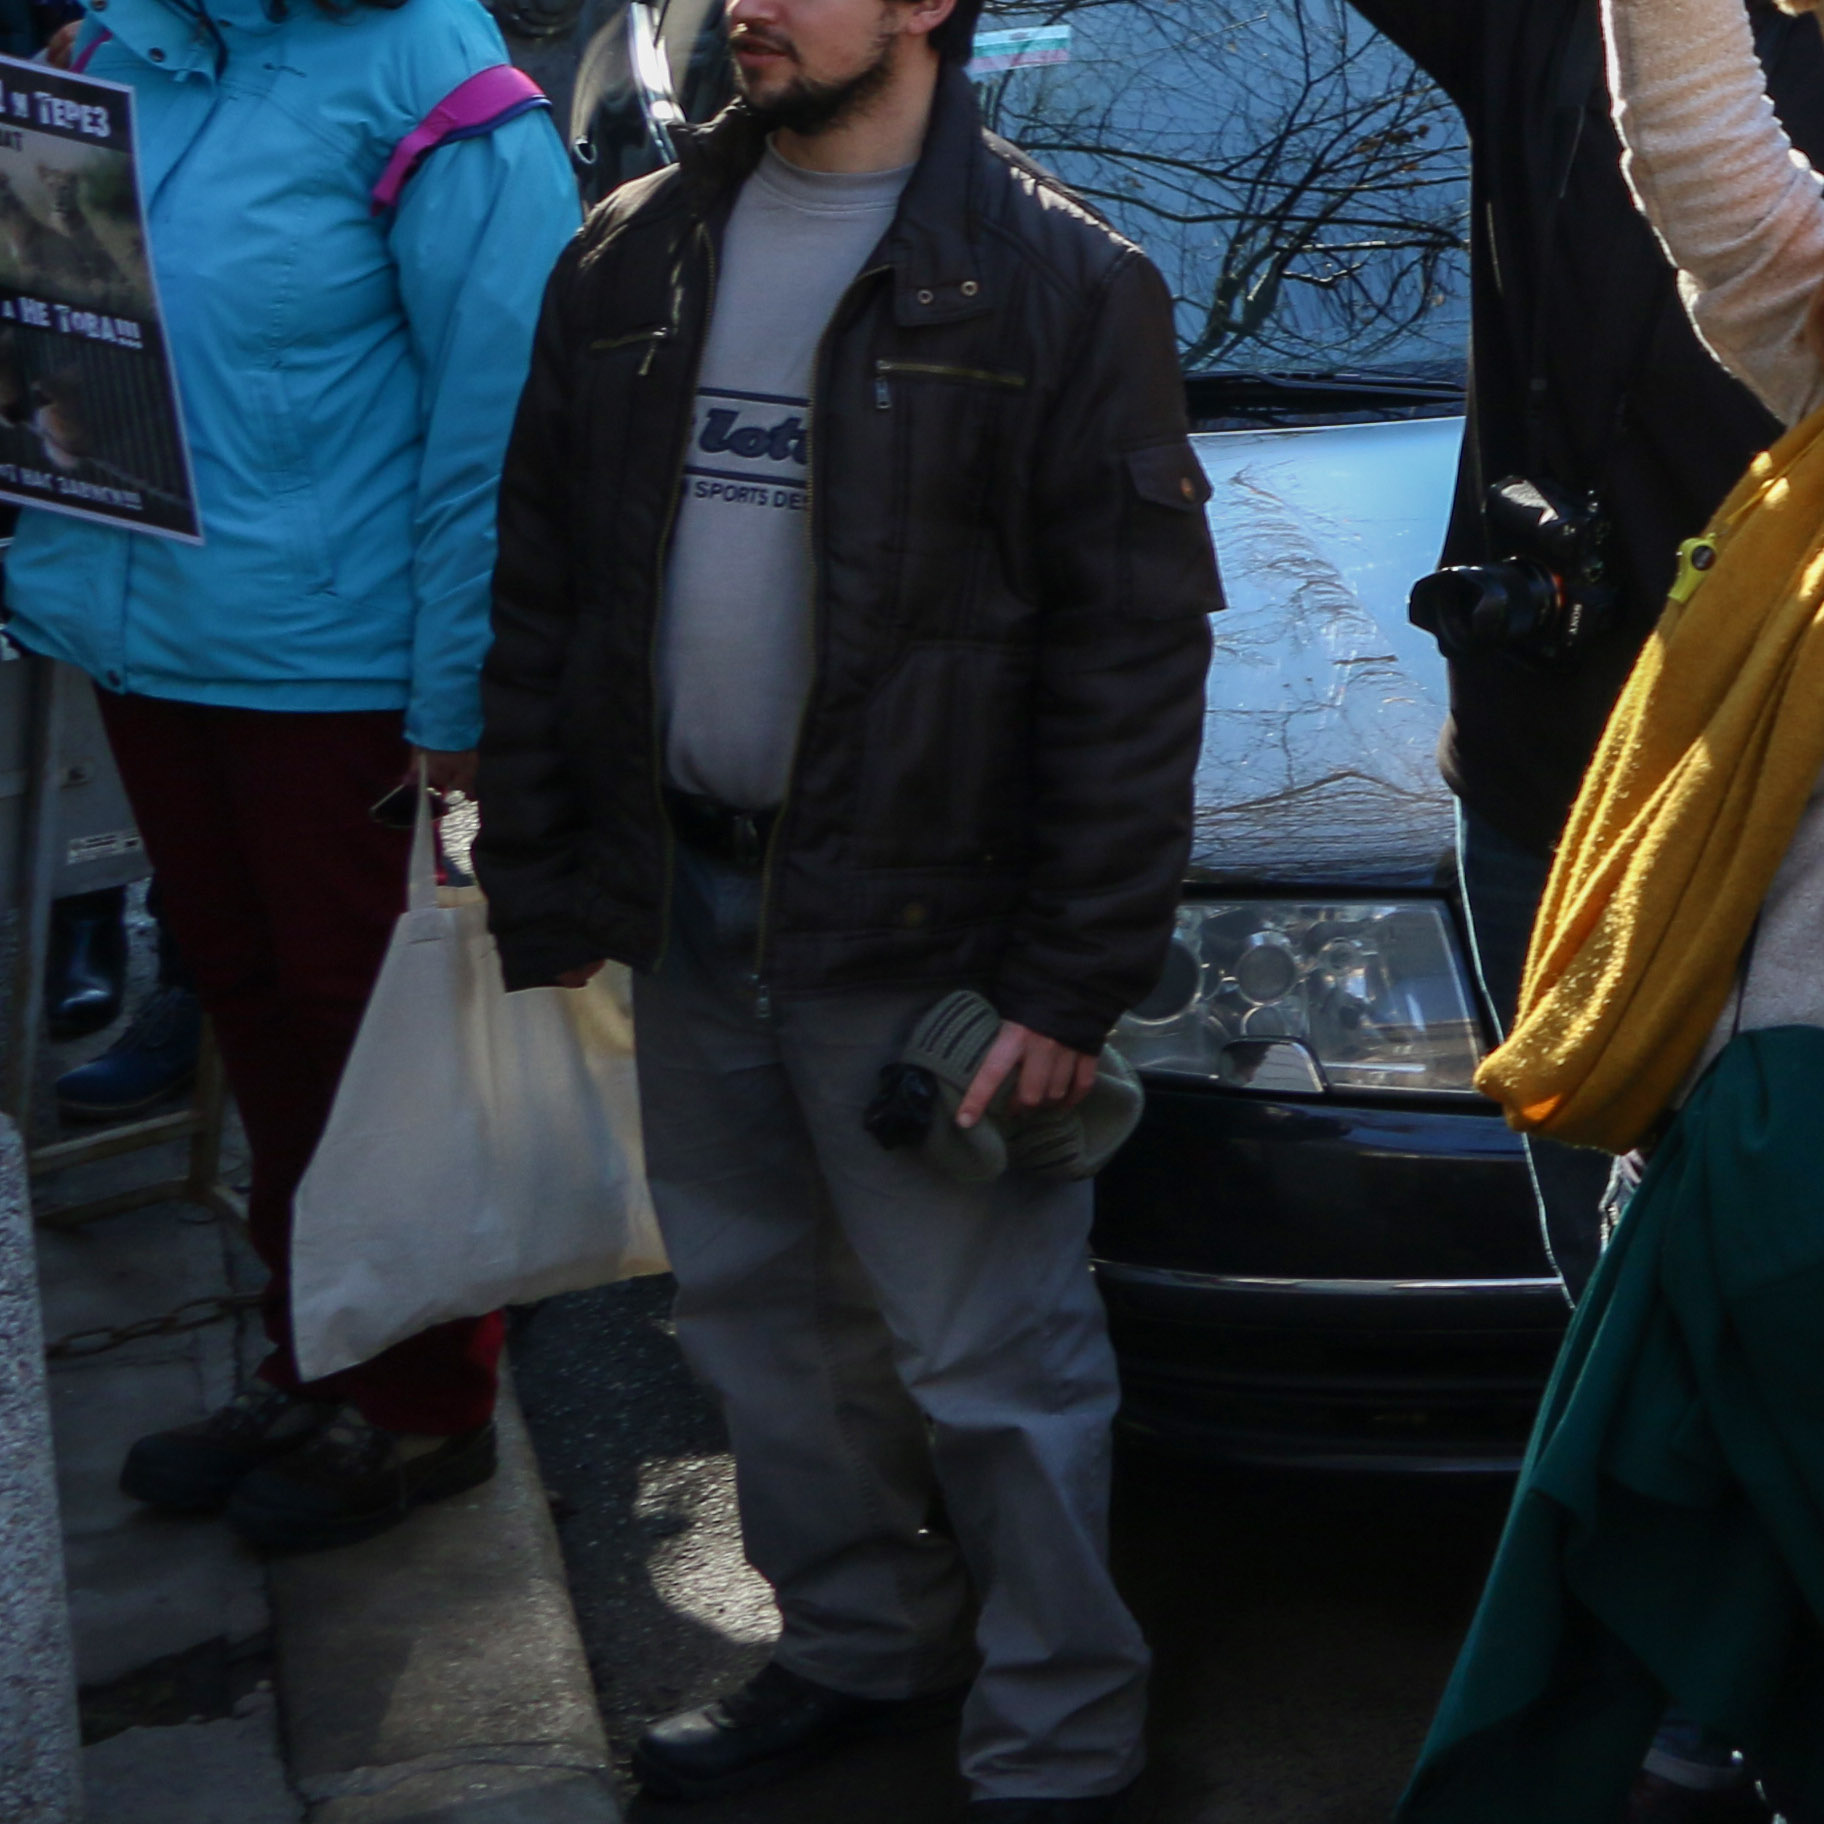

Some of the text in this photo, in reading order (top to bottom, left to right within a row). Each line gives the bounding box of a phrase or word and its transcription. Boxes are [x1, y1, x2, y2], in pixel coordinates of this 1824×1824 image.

[33, 89, 112, 138] ТЕРЕЗ
[693, 480, 806, 512] SPORTS DE
